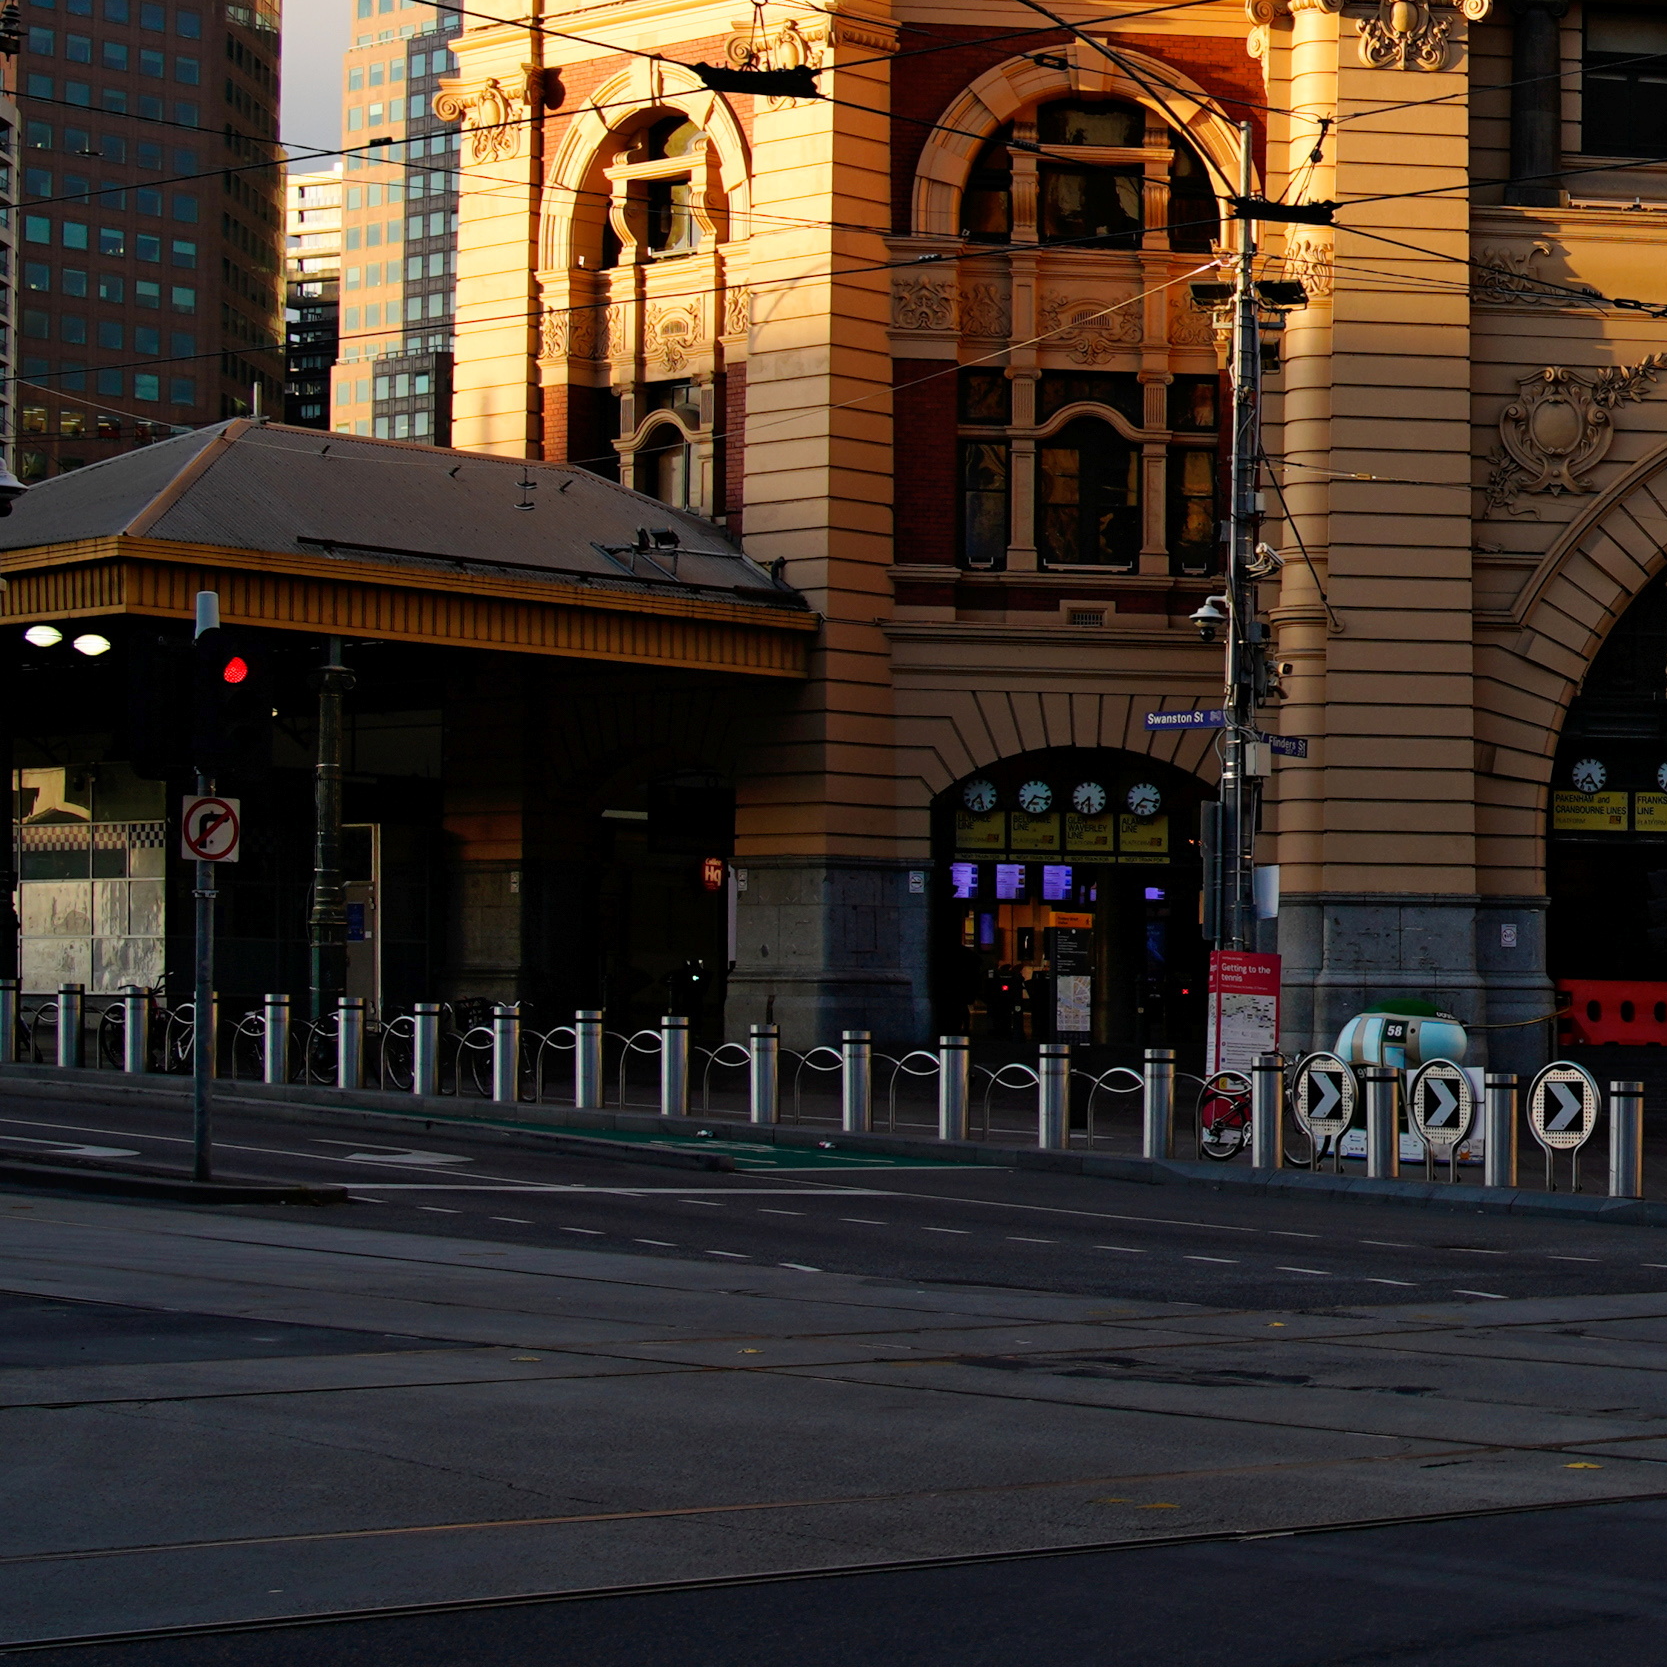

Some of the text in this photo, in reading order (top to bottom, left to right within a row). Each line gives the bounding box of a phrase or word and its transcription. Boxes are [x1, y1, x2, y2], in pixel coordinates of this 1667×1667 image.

[1147, 711, 1204, 725] Swanston St
[1269, 735, 1297, 750] Flinders
[1555, 795, 1594, 803] PAKENHAM
[1555, 805, 1627, 815] CRANBOURNE LINES
[1637, 807, 1654, 815] LINE
[957, 822, 975, 830] LINE
[1013, 823, 1029, 831] LINE
[1067, 824, 1107, 832] WAVERLEY
[1221, 963, 1271, 974] Getting to the
[1221, 973, 1243, 982] tennis
[1387, 1025, 1403, 1037] 58
